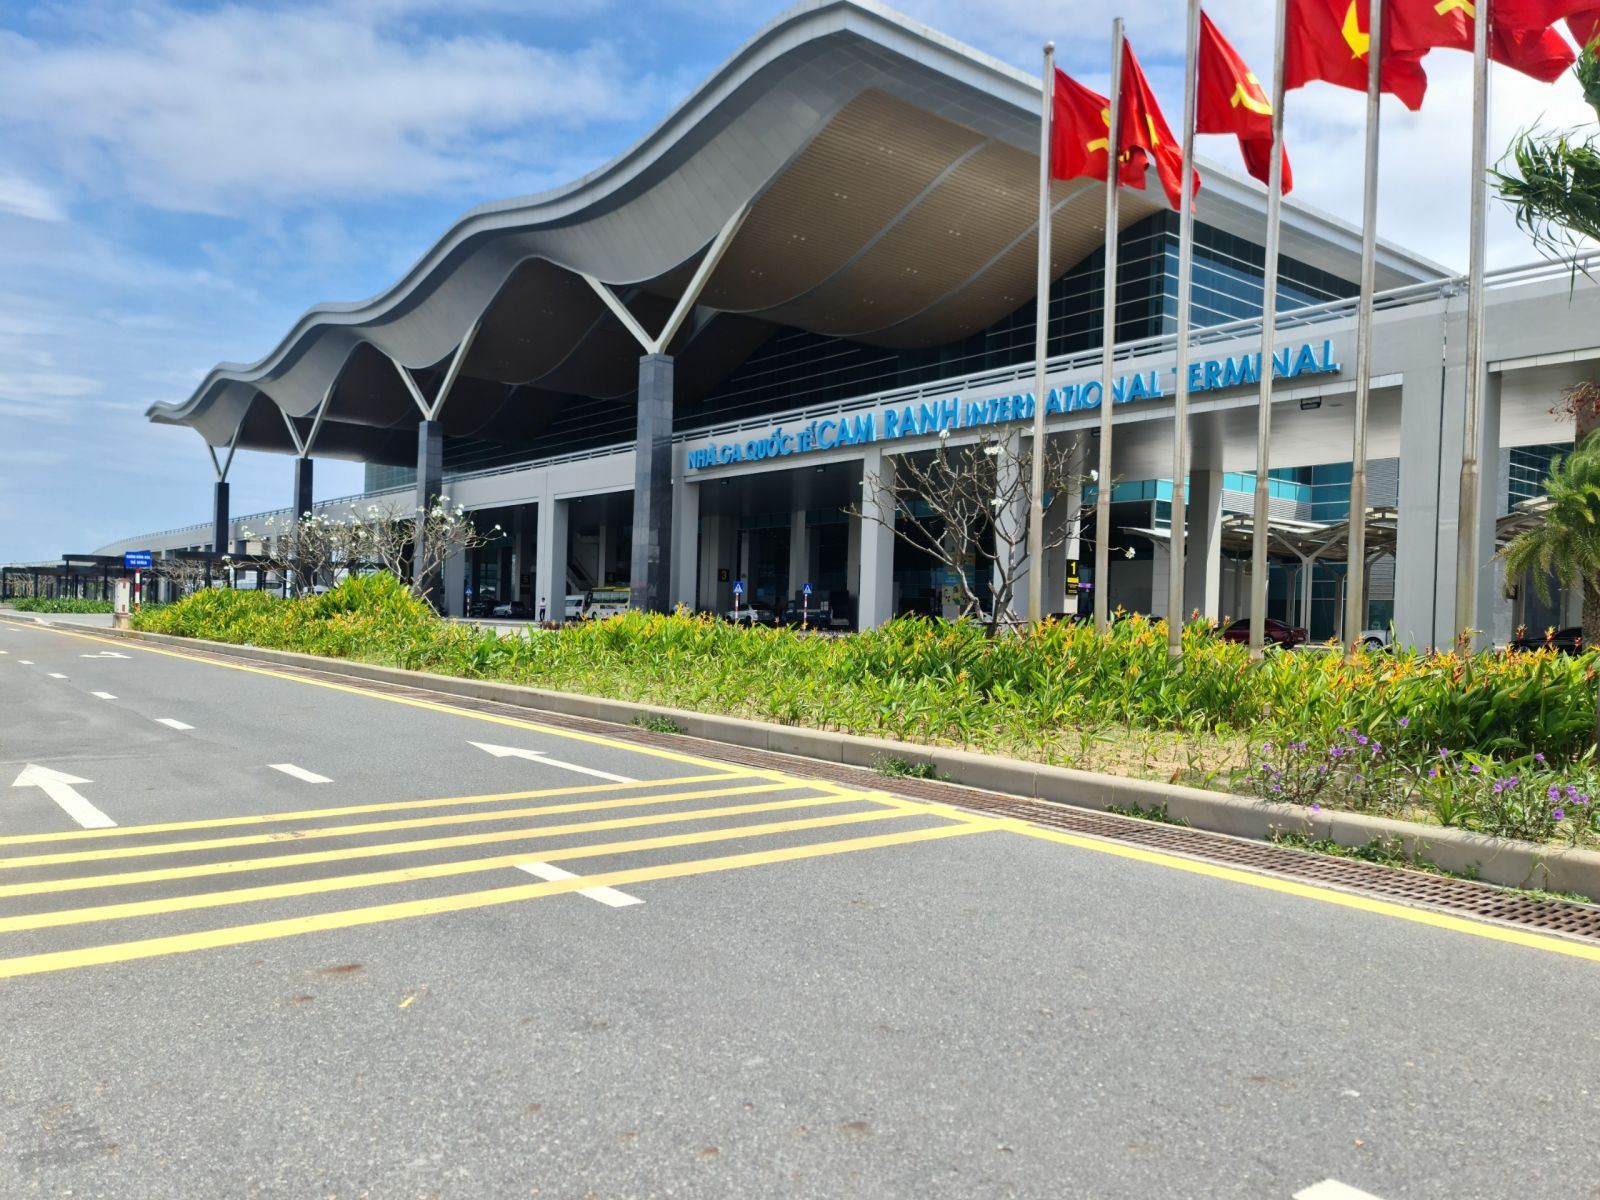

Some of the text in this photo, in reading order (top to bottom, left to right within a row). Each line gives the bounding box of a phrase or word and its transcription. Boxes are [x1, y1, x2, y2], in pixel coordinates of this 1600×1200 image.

[688, 339, 1340, 469] NHÀ GA QUỐC TẾ CAM RANH INTERNATIONAL ERMINAL
[1071, 561, 1076, 575] 1
